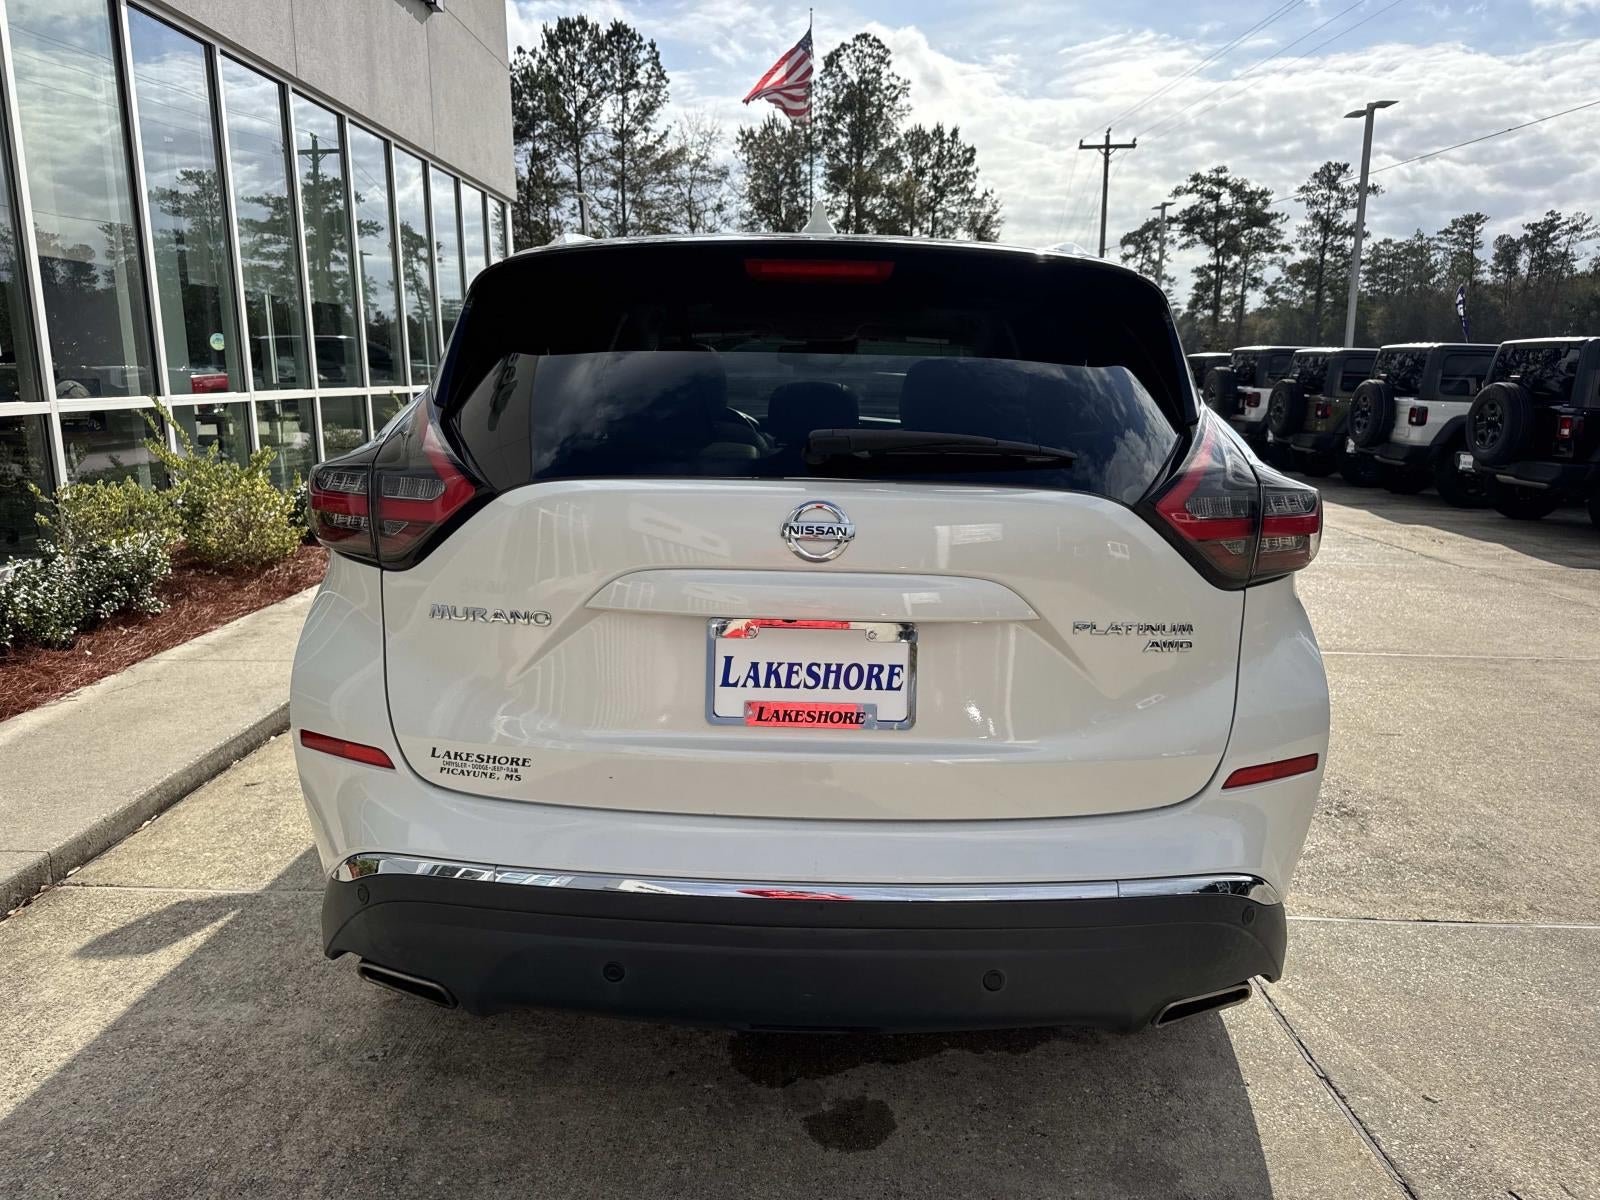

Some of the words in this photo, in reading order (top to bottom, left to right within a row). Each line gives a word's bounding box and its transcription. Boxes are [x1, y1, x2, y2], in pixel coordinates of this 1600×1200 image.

[788, 525, 848, 537] NISSAN
[429, 603, 553, 627] MURANO
[1072, 621, 1194, 636] PLATINUM
[1143, 639, 1193, 652] AWD
[719, 655, 904, 692] LAKESHORE
[755, 706, 866, 725] LAKESHORE
[430, 747, 532, 768] LAKESHORE
[439, 767, 500, 780] PICAYUNE,
